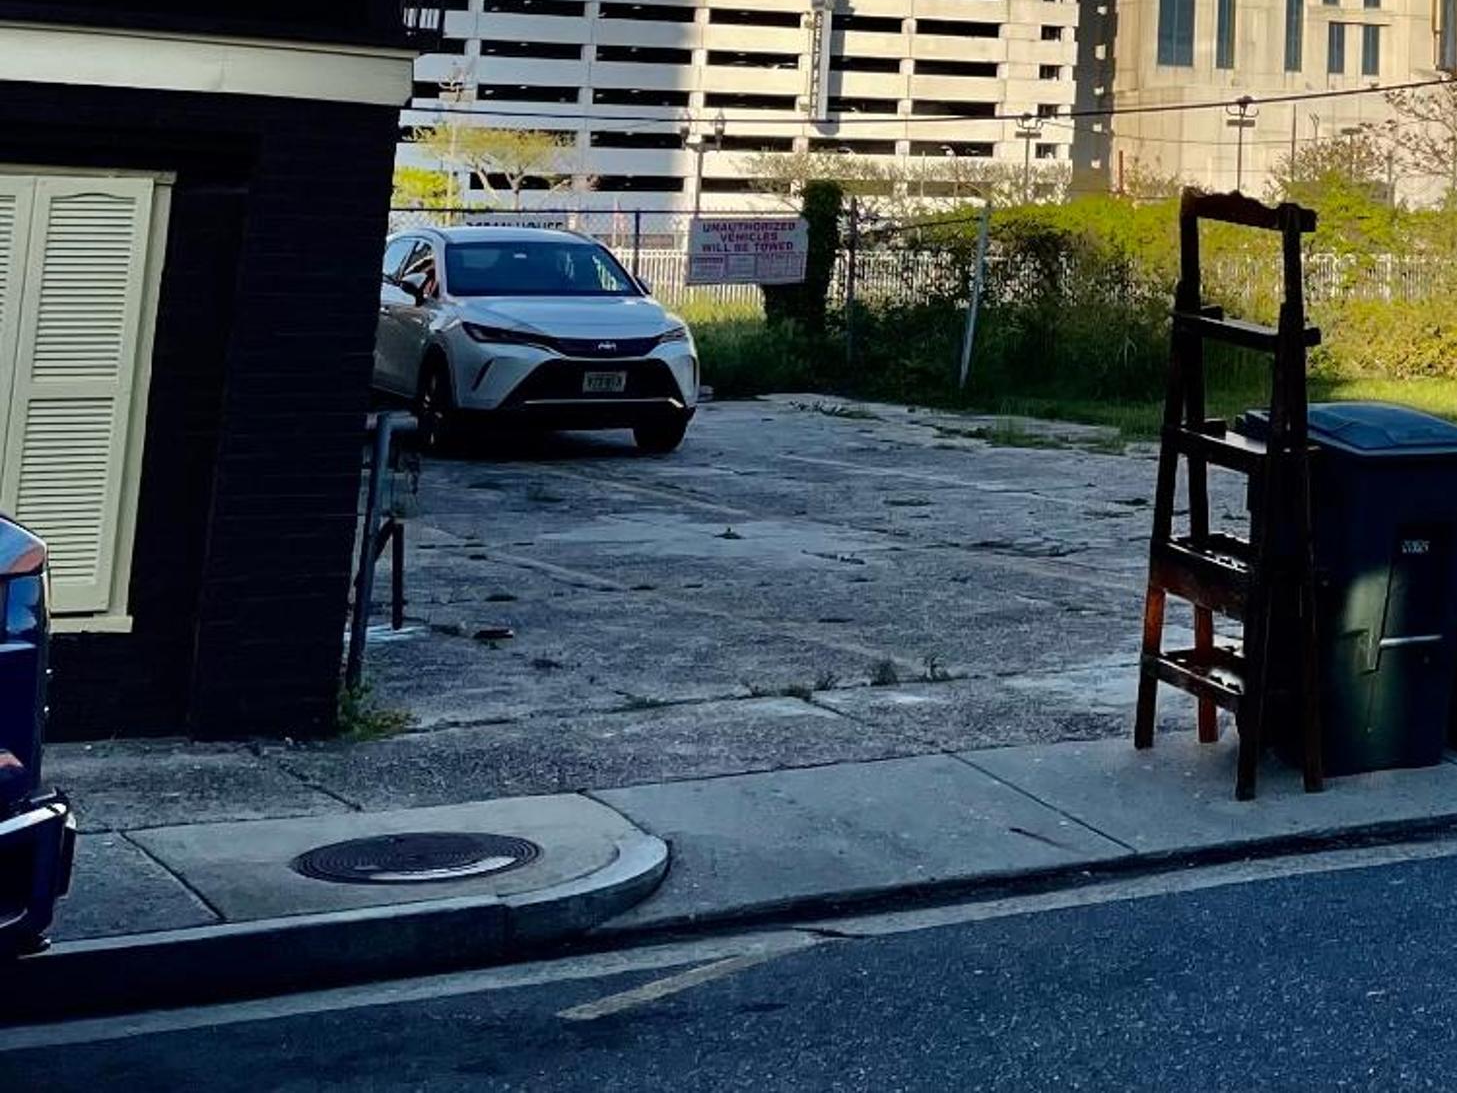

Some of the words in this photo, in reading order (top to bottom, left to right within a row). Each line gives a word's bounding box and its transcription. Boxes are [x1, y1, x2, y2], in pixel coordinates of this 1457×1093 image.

[702, 222, 796, 233] UNAUTHORIZED
[720, 232, 778, 243] VEHICLES
[702, 243, 732, 252] WILL
[735, 243, 748, 252] BE
[755, 241, 794, 251] TOWED
